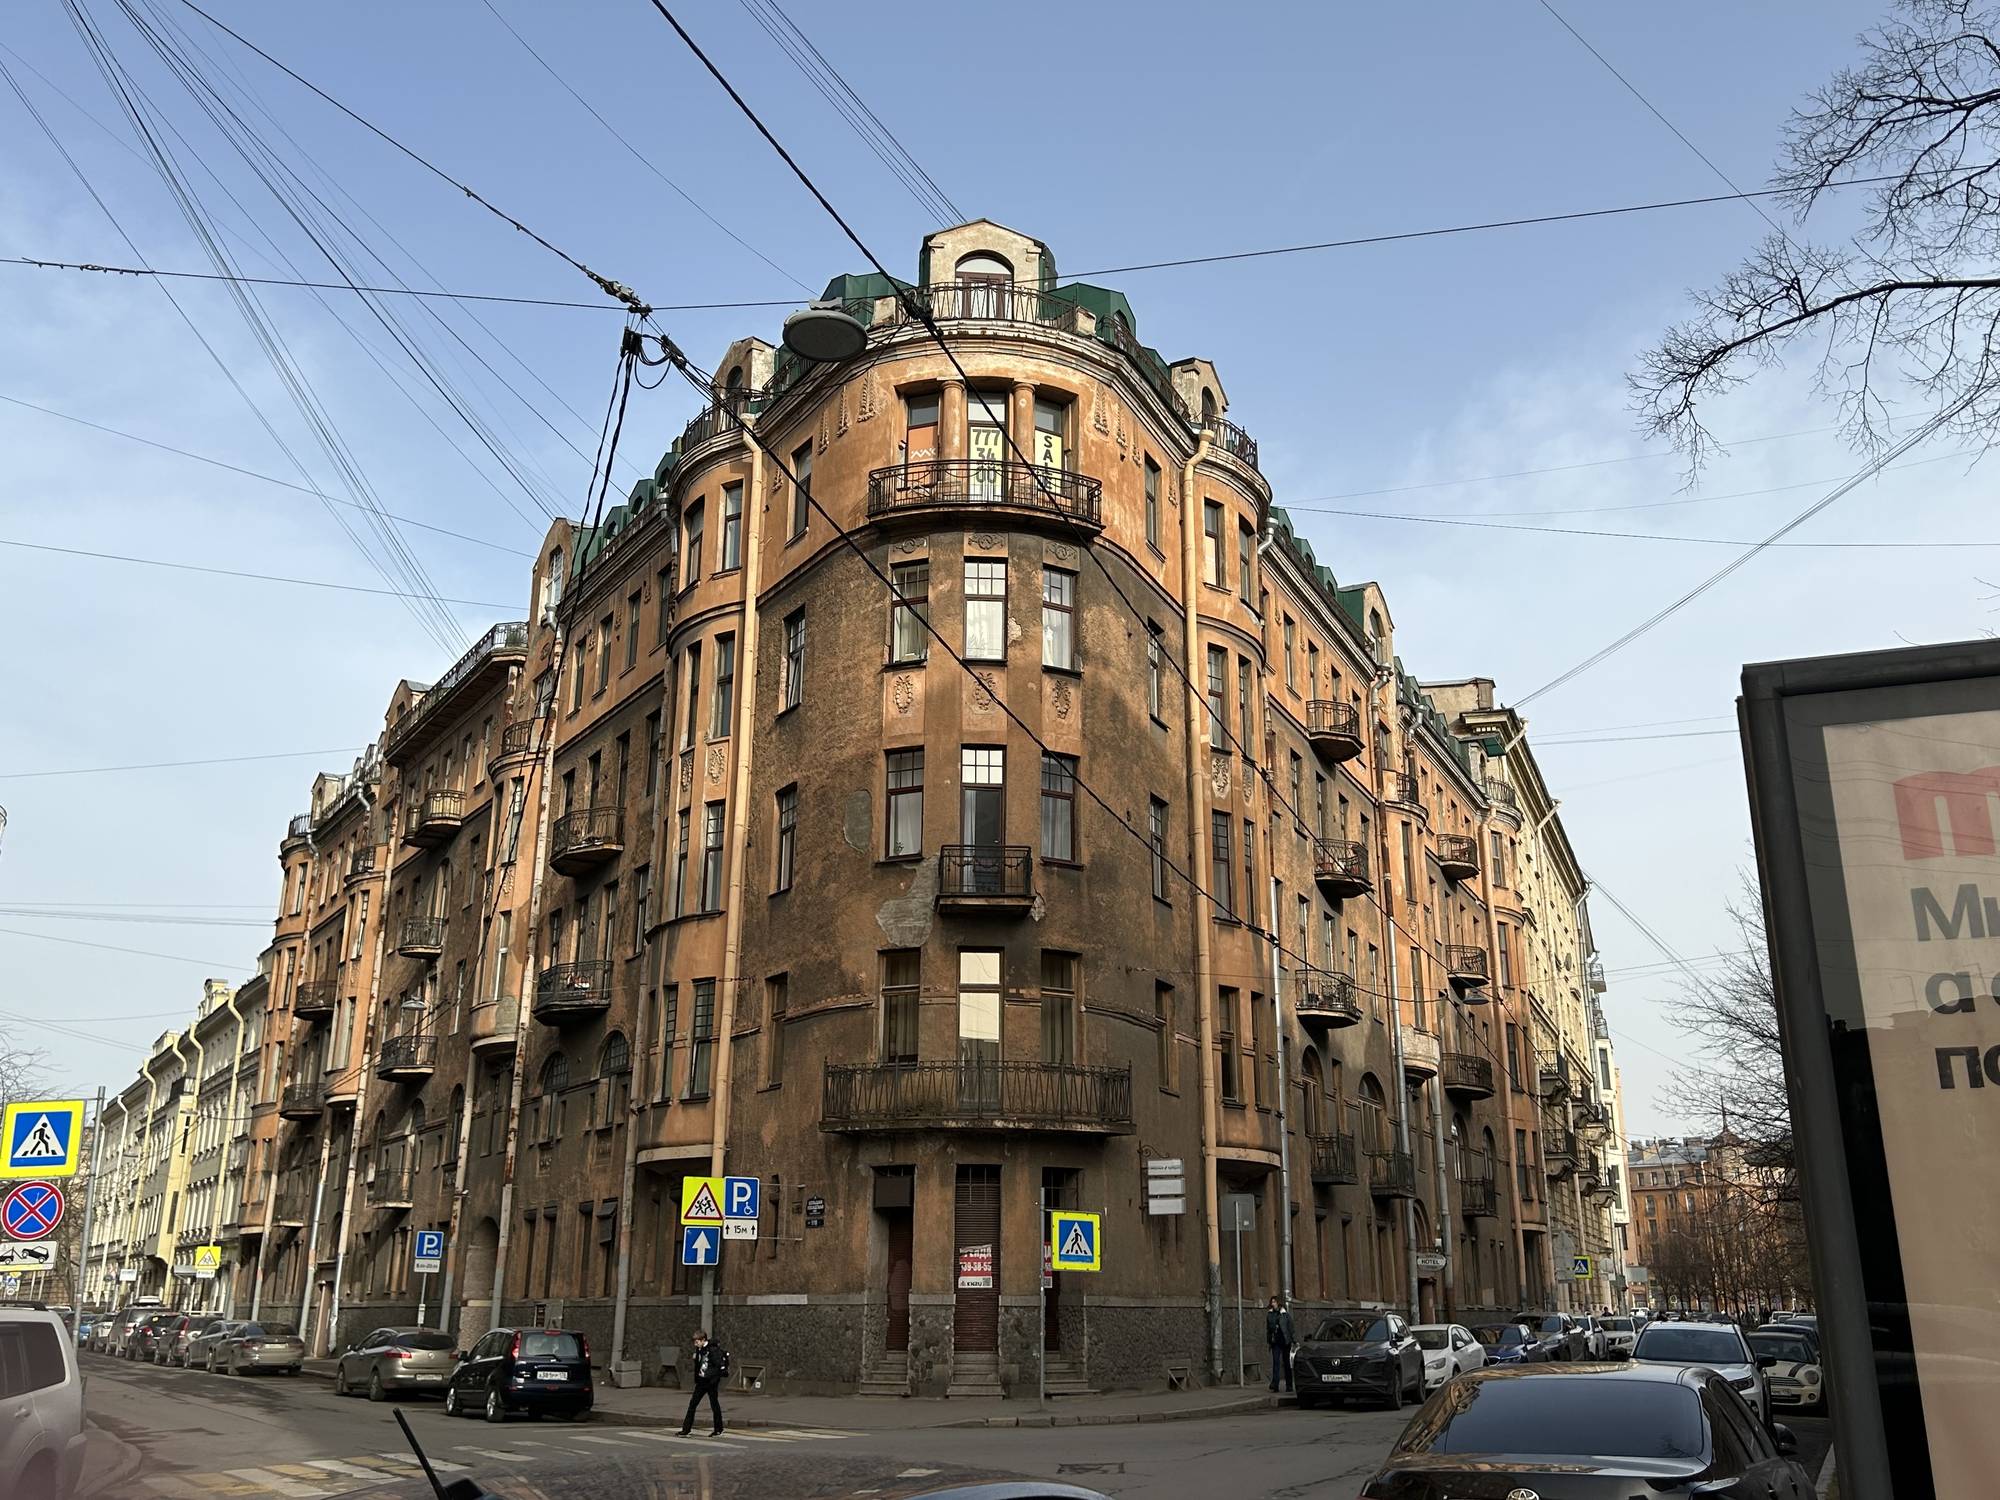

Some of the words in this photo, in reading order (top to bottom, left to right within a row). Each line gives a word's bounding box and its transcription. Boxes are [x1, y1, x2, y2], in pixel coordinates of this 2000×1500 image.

[972, 428, 1001, 446] 777
[732, 1181, 752, 1213] P
[423, 1234, 438, 1255] P
